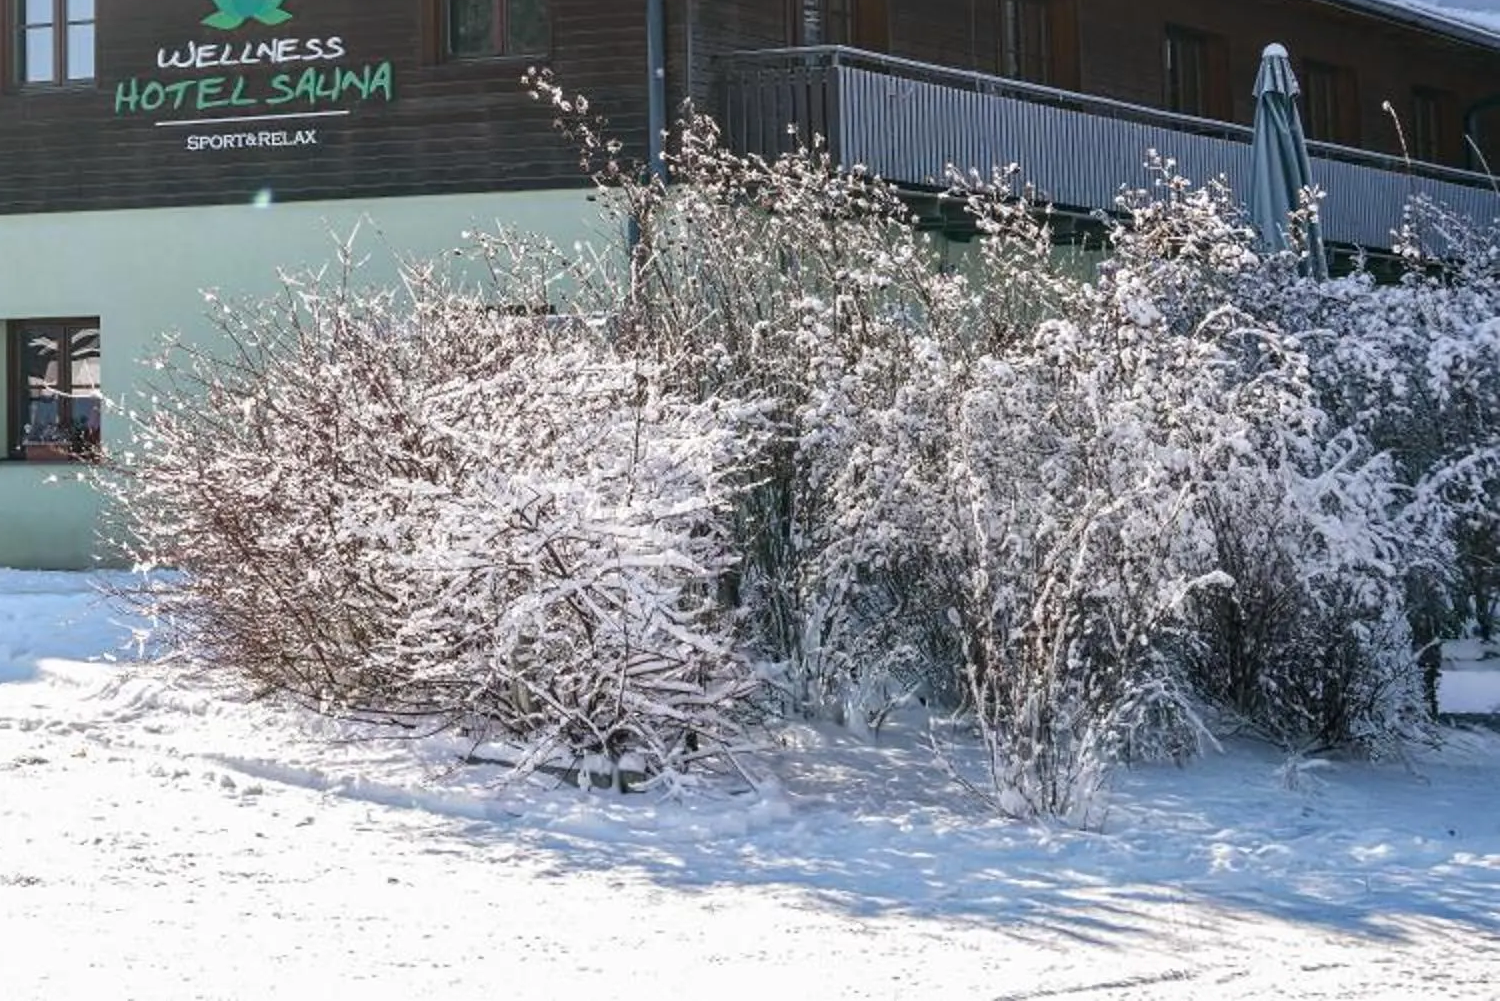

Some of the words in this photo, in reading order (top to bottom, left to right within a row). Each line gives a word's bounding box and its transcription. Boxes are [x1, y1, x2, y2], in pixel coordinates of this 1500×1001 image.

[157, 37, 345, 68] WELLNESS
[115, 77, 255, 112] HOTEL
[266, 62, 392, 104] SAUNA
[187, 130, 316, 150] SPORT&RELAX
